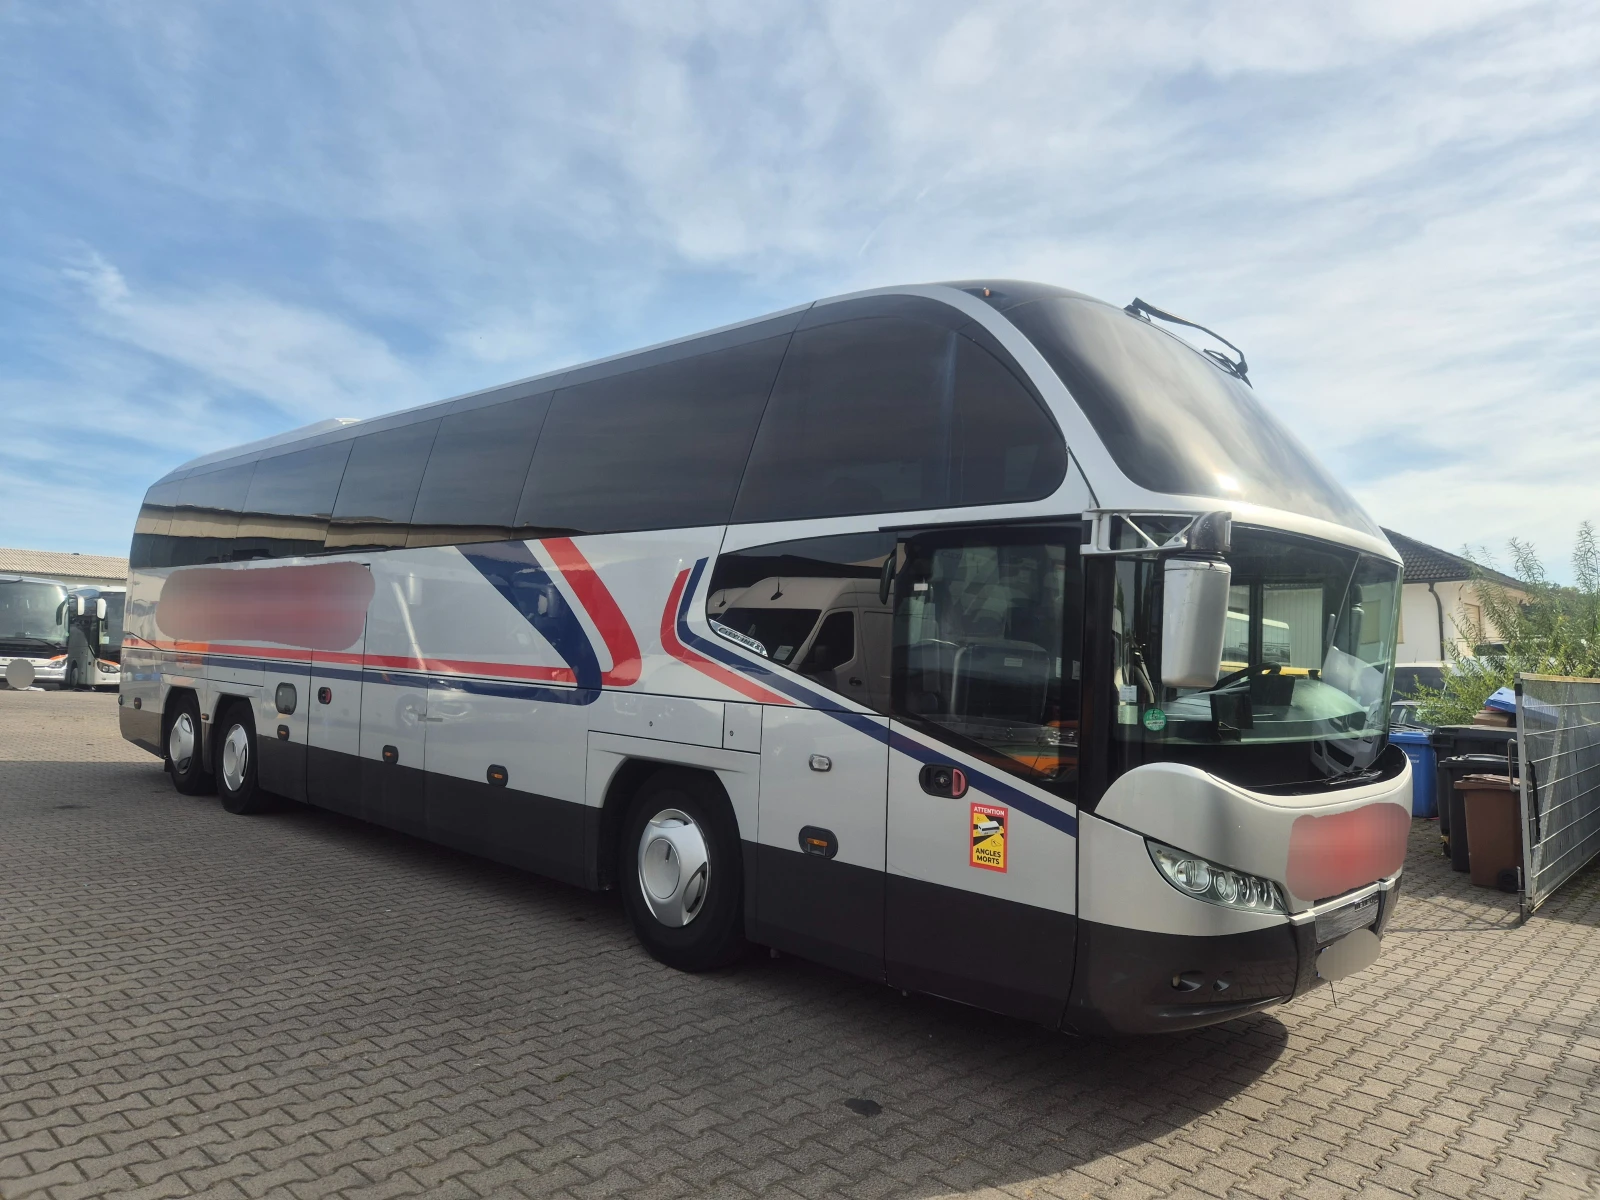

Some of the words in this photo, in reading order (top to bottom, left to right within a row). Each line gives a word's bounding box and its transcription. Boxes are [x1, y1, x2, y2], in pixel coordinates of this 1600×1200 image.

[974, 806, 1005, 815] ATTENTION
[975, 848, 1001, 857] ANGLES
[976, 855, 1000, 864] MORTS
